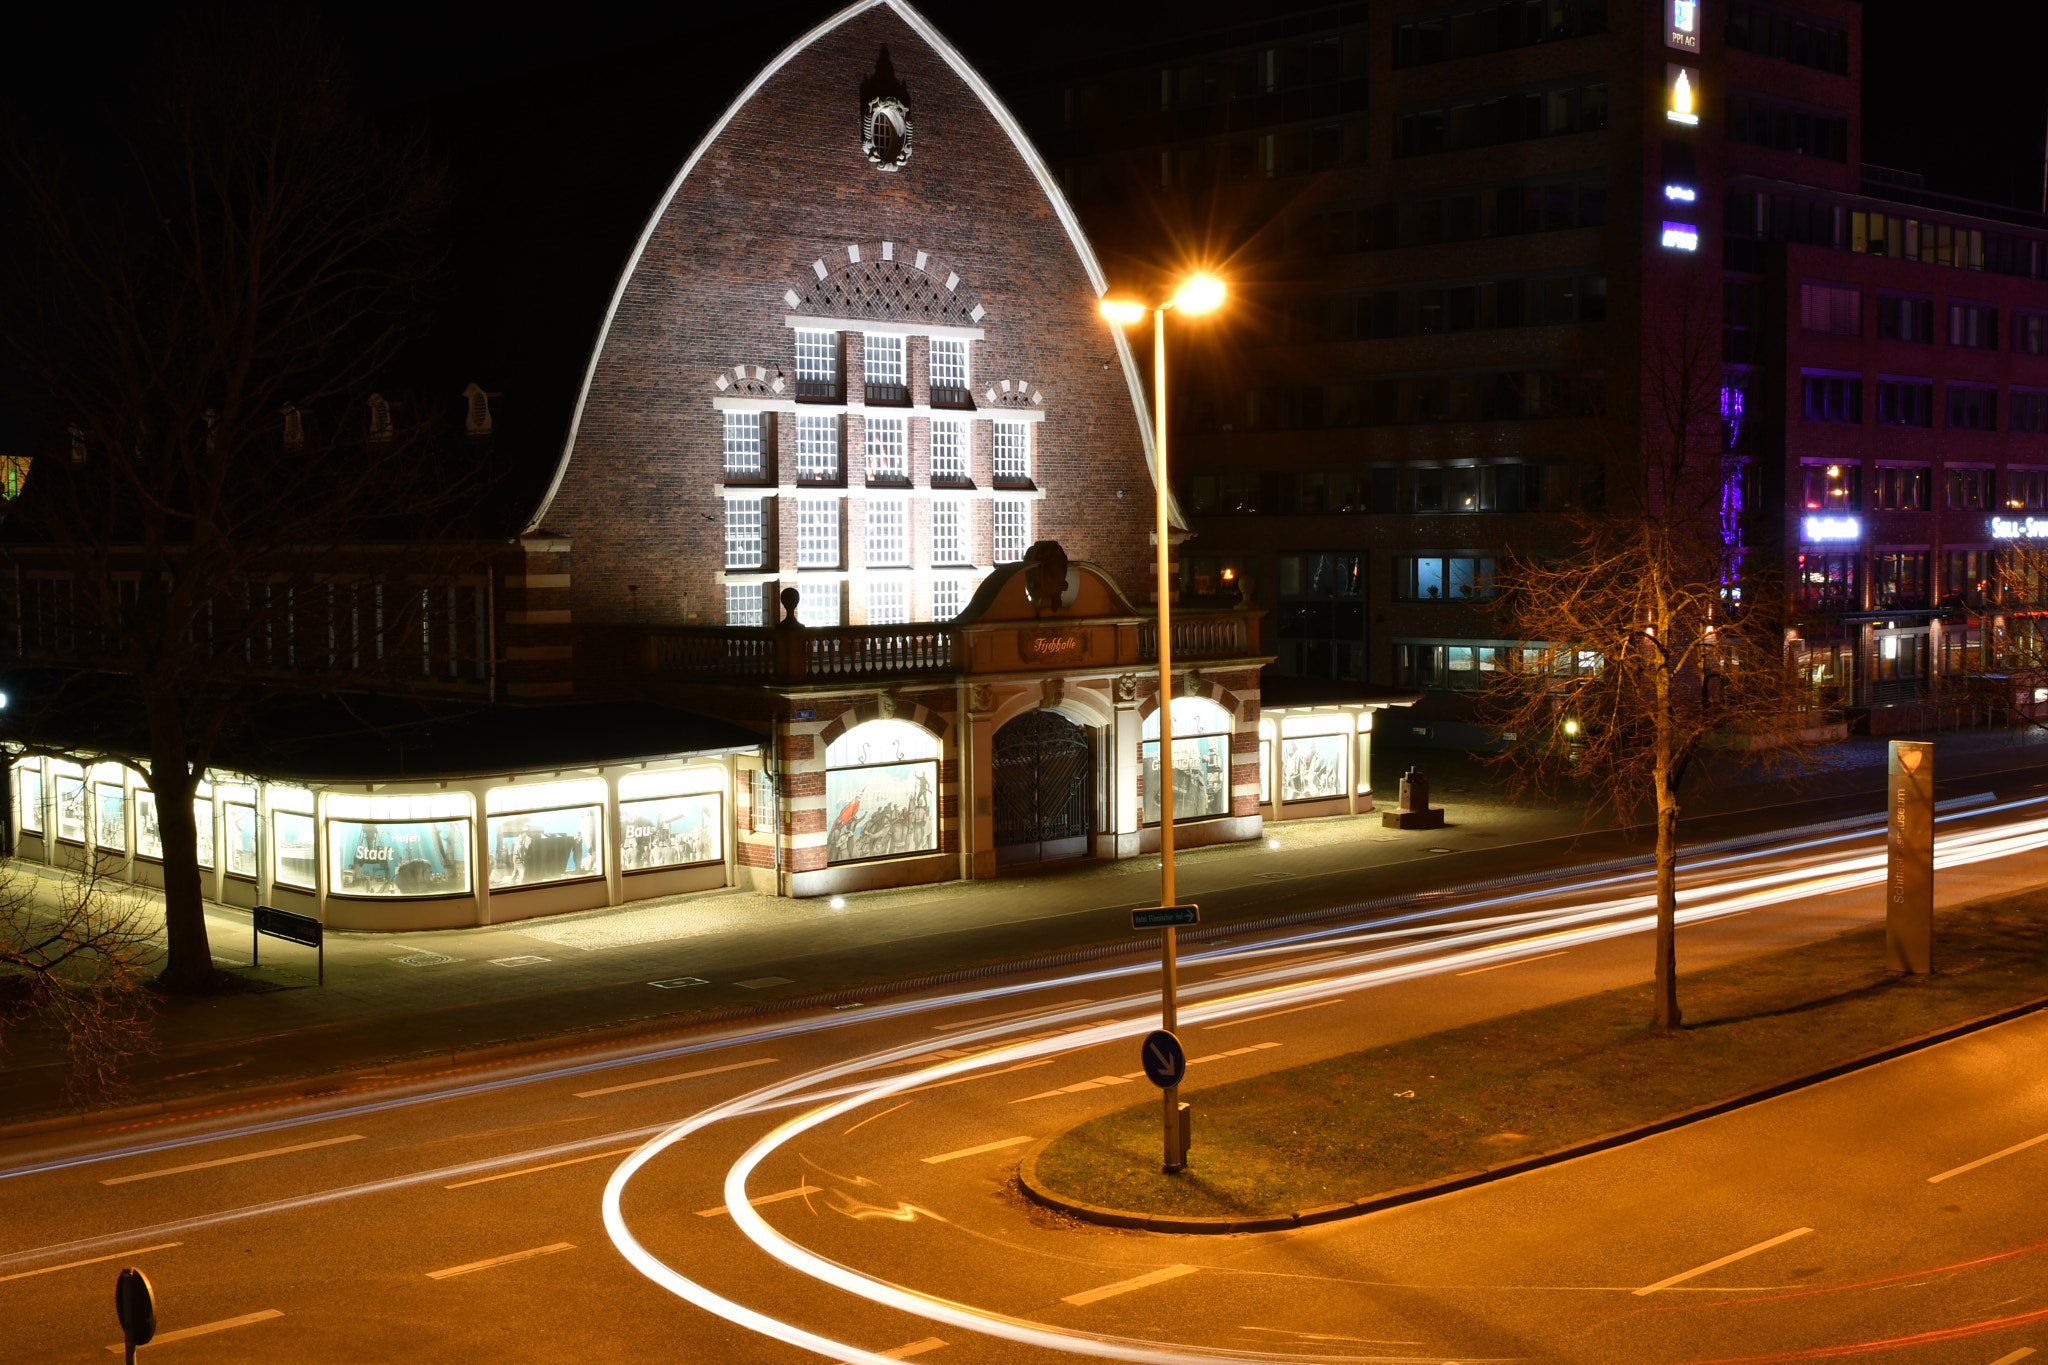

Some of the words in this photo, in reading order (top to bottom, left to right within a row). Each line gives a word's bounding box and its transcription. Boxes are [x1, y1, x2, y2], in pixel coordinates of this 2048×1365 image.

[1672, 32, 1684, 44] PPI
[1685, 36, 1696, 47] AG
[1033, 637, 1077, 654] Fischhalle
[391, 833, 421, 844] Hafen
[626, 825, 651, 838] Bau
[356, 845, 395, 861] Stadt
